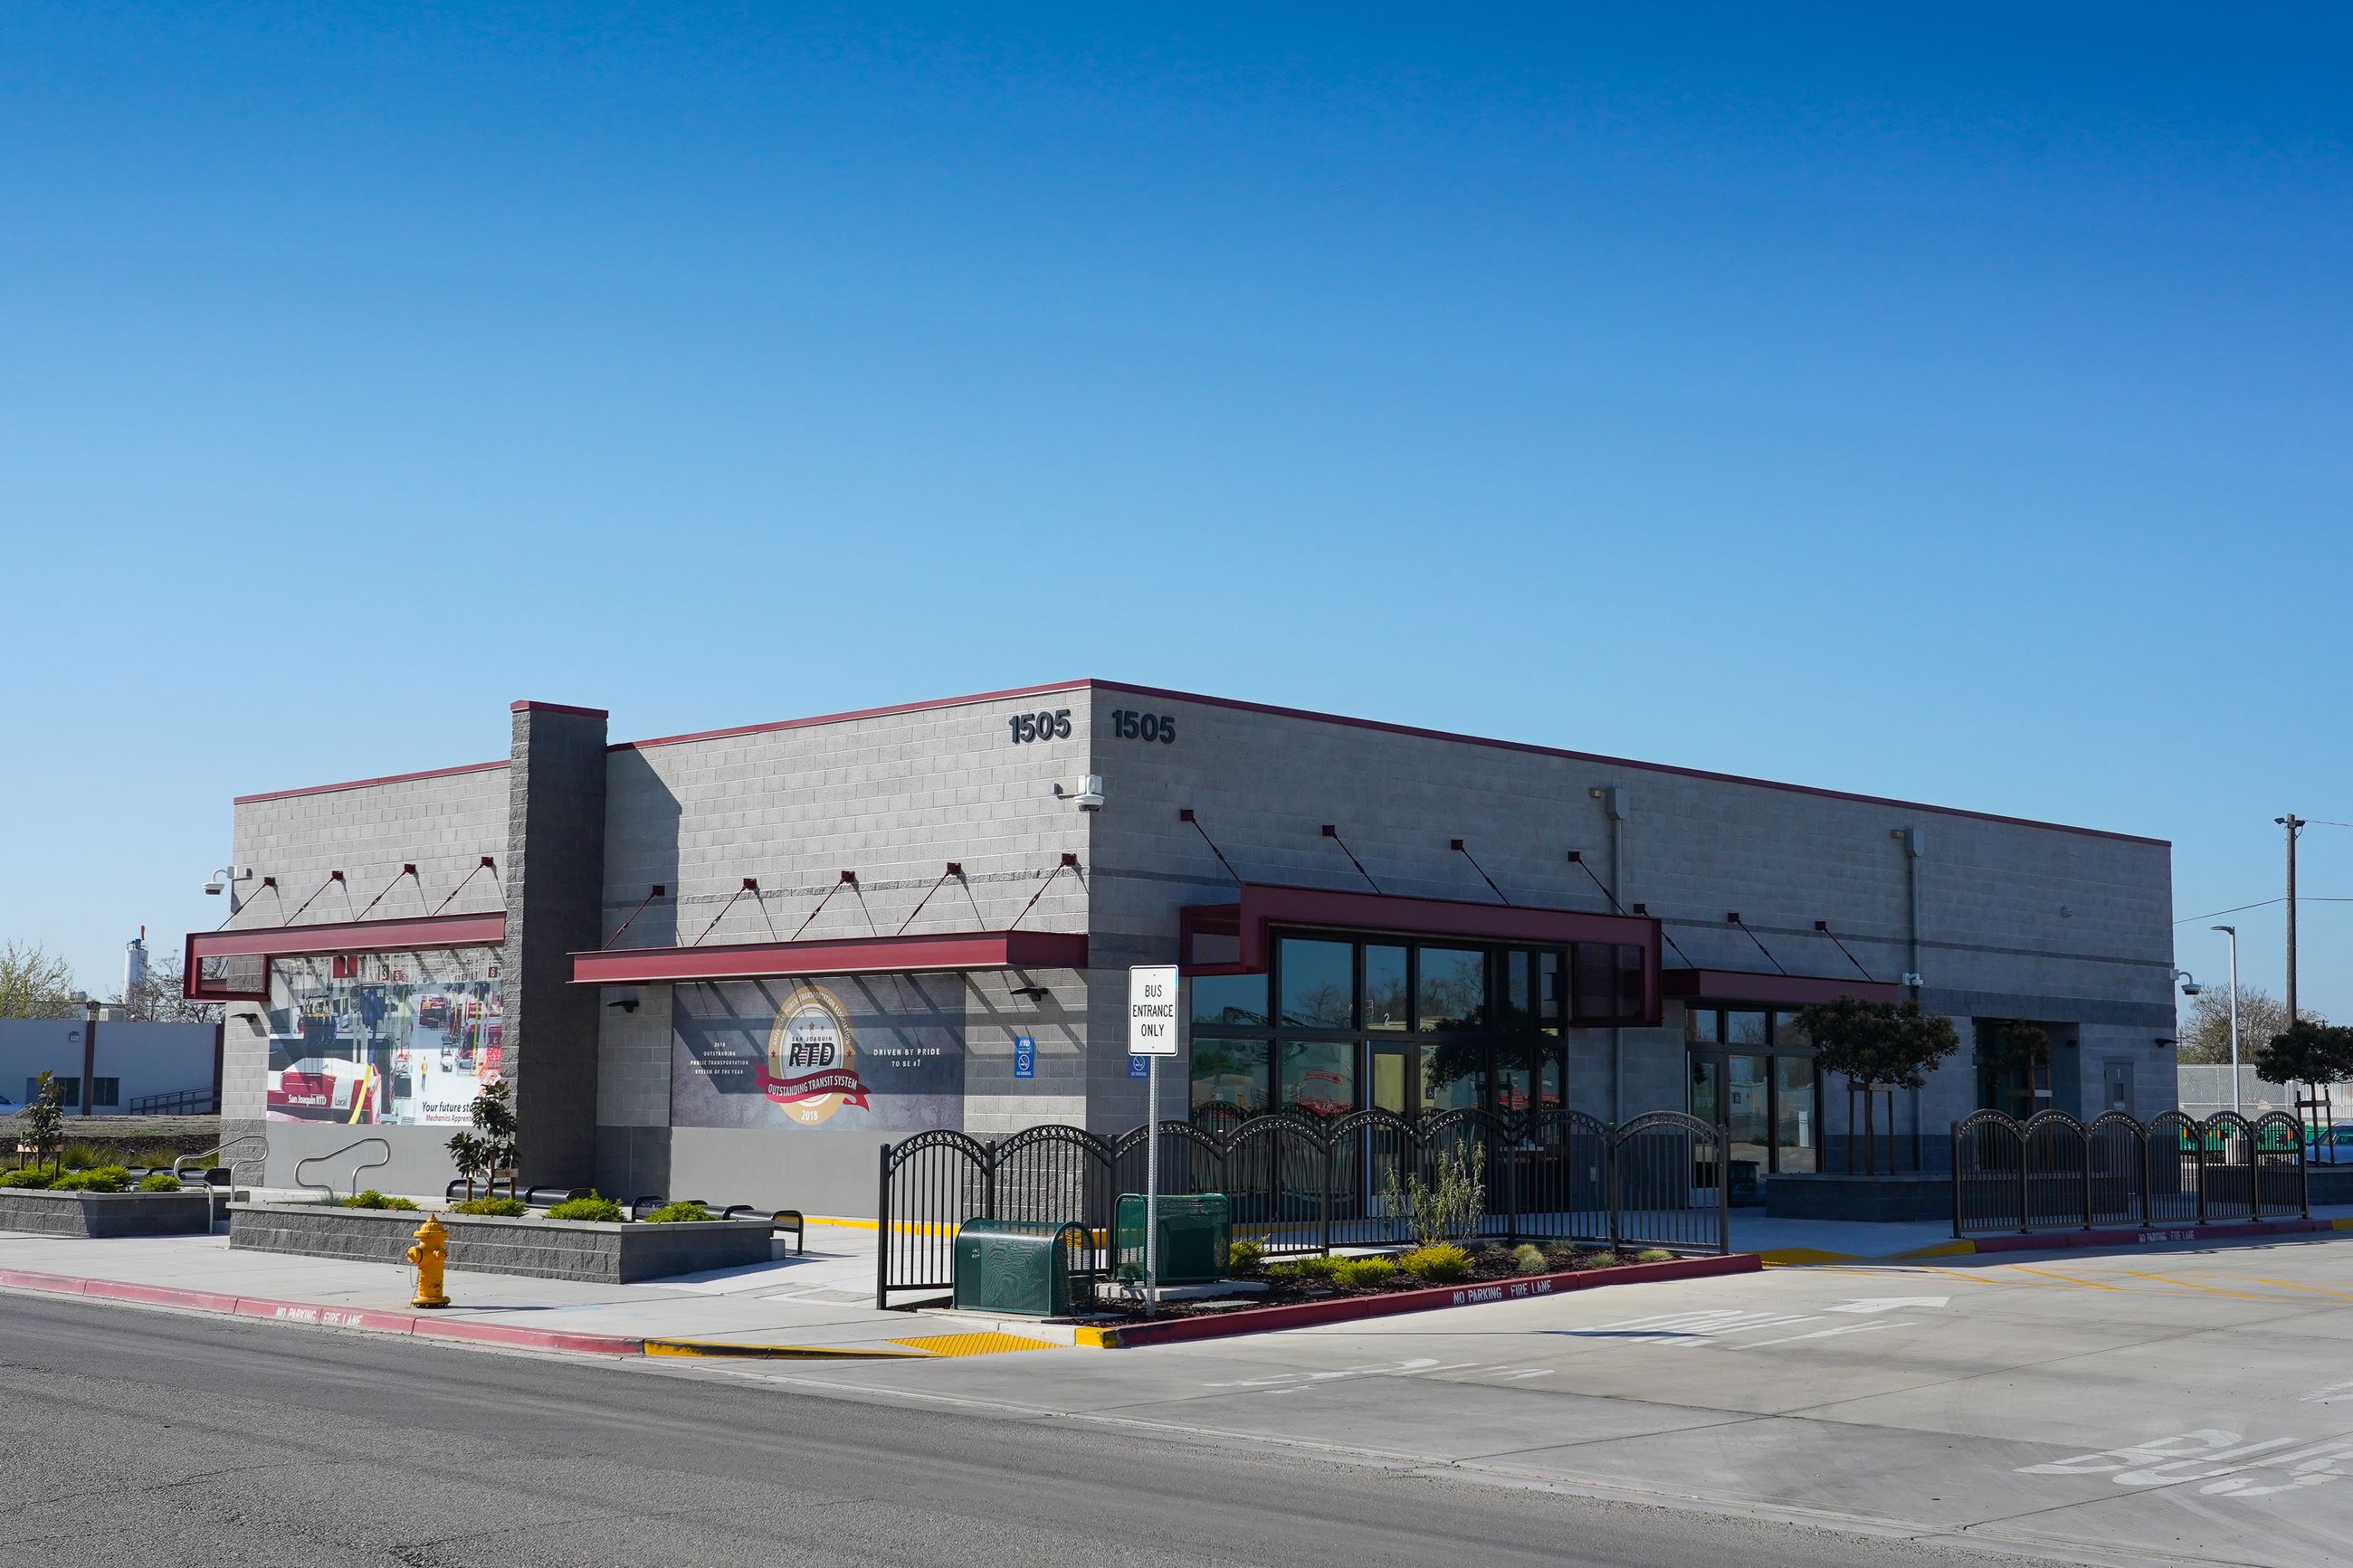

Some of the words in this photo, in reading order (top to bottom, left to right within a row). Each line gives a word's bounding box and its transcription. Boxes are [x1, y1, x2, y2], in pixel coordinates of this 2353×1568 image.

[1009, 709, 1072, 745] 1505
[1112, 709, 1176, 745] 1505
[1145, 984, 1163, 997] BUS
[1132, 1004, 1174, 1017] ENTRANCE
[785, 996, 800, 1015] PUBLIC
[799, 991, 836, 1009] TRANSPORTATION
[834, 1005, 853, 1045] ASSOCIATION
[1140, 1023, 1165, 1037] ONLY
[788, 1042, 835, 1067] RTD
[917, 1048, 940, 1056] PRIDE
[913, 1059, 920, 1067] #1
[767, 1082, 808, 1097] OUTSTANDING
[808, 1075, 834, 1091] TRANSIT
[834, 1074, 858, 1090] SYSTEM
[288, 1094, 297, 1103] San
[297, 1095, 316, 1107] Joaquin
[316, 1096, 327, 1105] RTD
[335, 1098, 348, 1107] Local
[422, 1101, 438, 1112] Your
[439, 1101, 462, 1112] future
[425, 1114, 452, 1122] Mechanics
[801, 1109, 818, 1121] 2018
[1453, 1291, 1465, 1305] NO
[1468, 1286, 1501, 1302] PARKING
[1510, 1283, 1529, 1297] FIRE
[1531, 1280, 1553, 1294] LANE
[275, 1307, 287, 1318] NO
[289, 1307, 317, 1320] PARKING
[323, 1312, 341, 1323] FIRE
[341, 1314, 363, 1327] LANE
